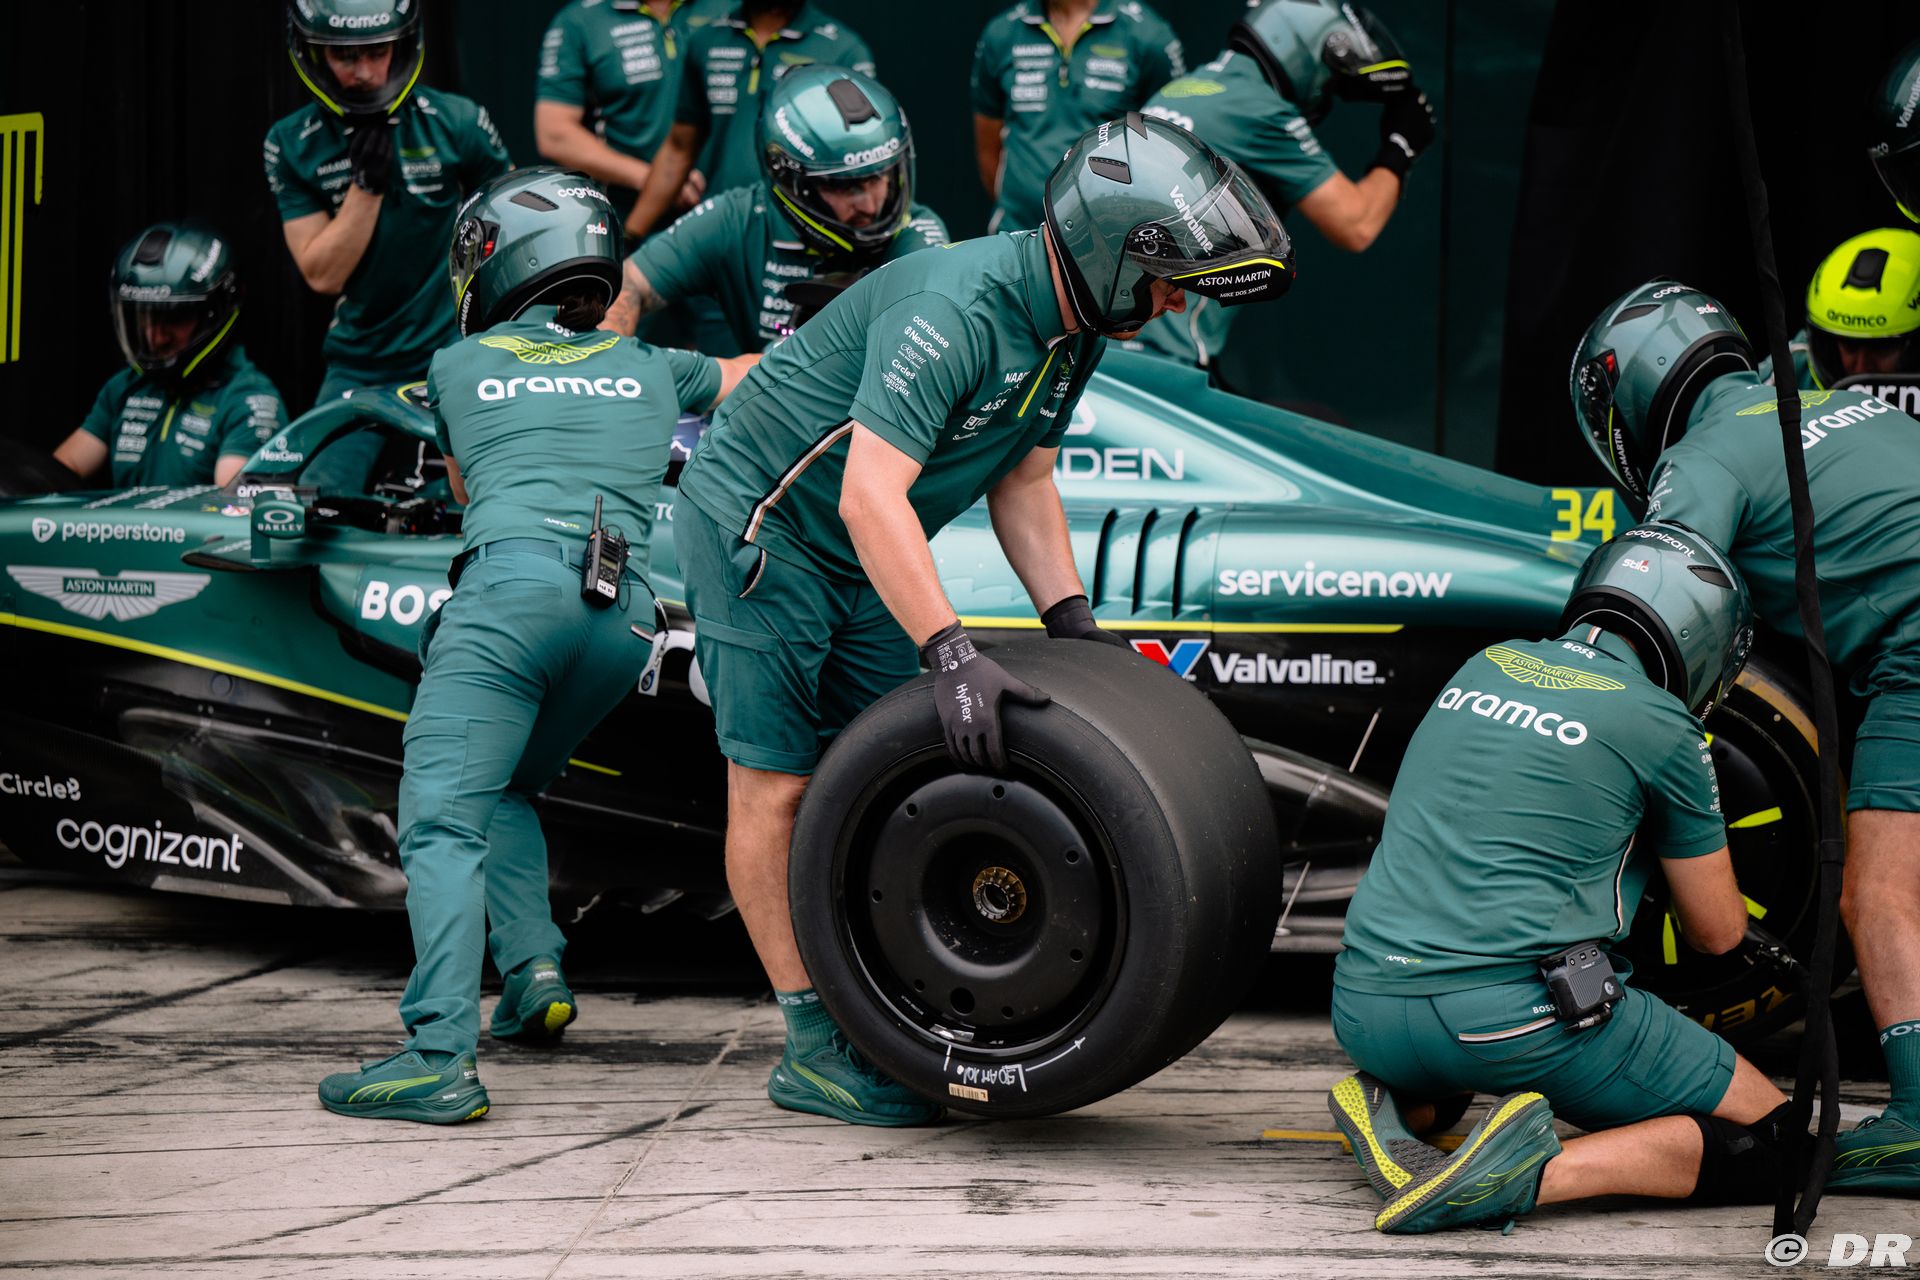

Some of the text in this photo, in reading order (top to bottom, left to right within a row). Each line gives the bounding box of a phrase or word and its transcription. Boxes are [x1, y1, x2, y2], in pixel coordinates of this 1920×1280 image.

[329, 12, 390, 28] aramco
[844, 137, 900, 165] aramco
[1169, 184, 1214, 254] Valvoline
[1197, 269, 1272, 287] ASTON MARTIN
[912, 315, 950, 348] coinbase
[1827, 309, 1888, 327] aramco
[908, 329, 941, 361] NexGen
[477, 376, 642, 401] aramco
[1800, 397, 1899, 450] aramc
[260, 449, 303, 463] NexGen
[1551, 488, 1616, 542] 34
[62, 521, 186, 543] pepperstone
[1625, 529, 1696, 558] cognizant
[66, 579, 153, 595] ASTON MARTIN
[1217, 561, 1453, 598] servicenow
[361, 580, 453, 625] BOS
[1561, 641, 1597, 660] BOSS
[1208, 651, 1378, 684] Valvoline
[1511, 656, 1578, 682] ASTON MARTIN
[955, 683, 973, 722] HyFlex
[1437, 687, 1589, 746] aramco
[56, 818, 244, 873] cognizant
[776, 992, 820, 1006] OSS
[1532, 1004, 1556, 1014] BOSS
